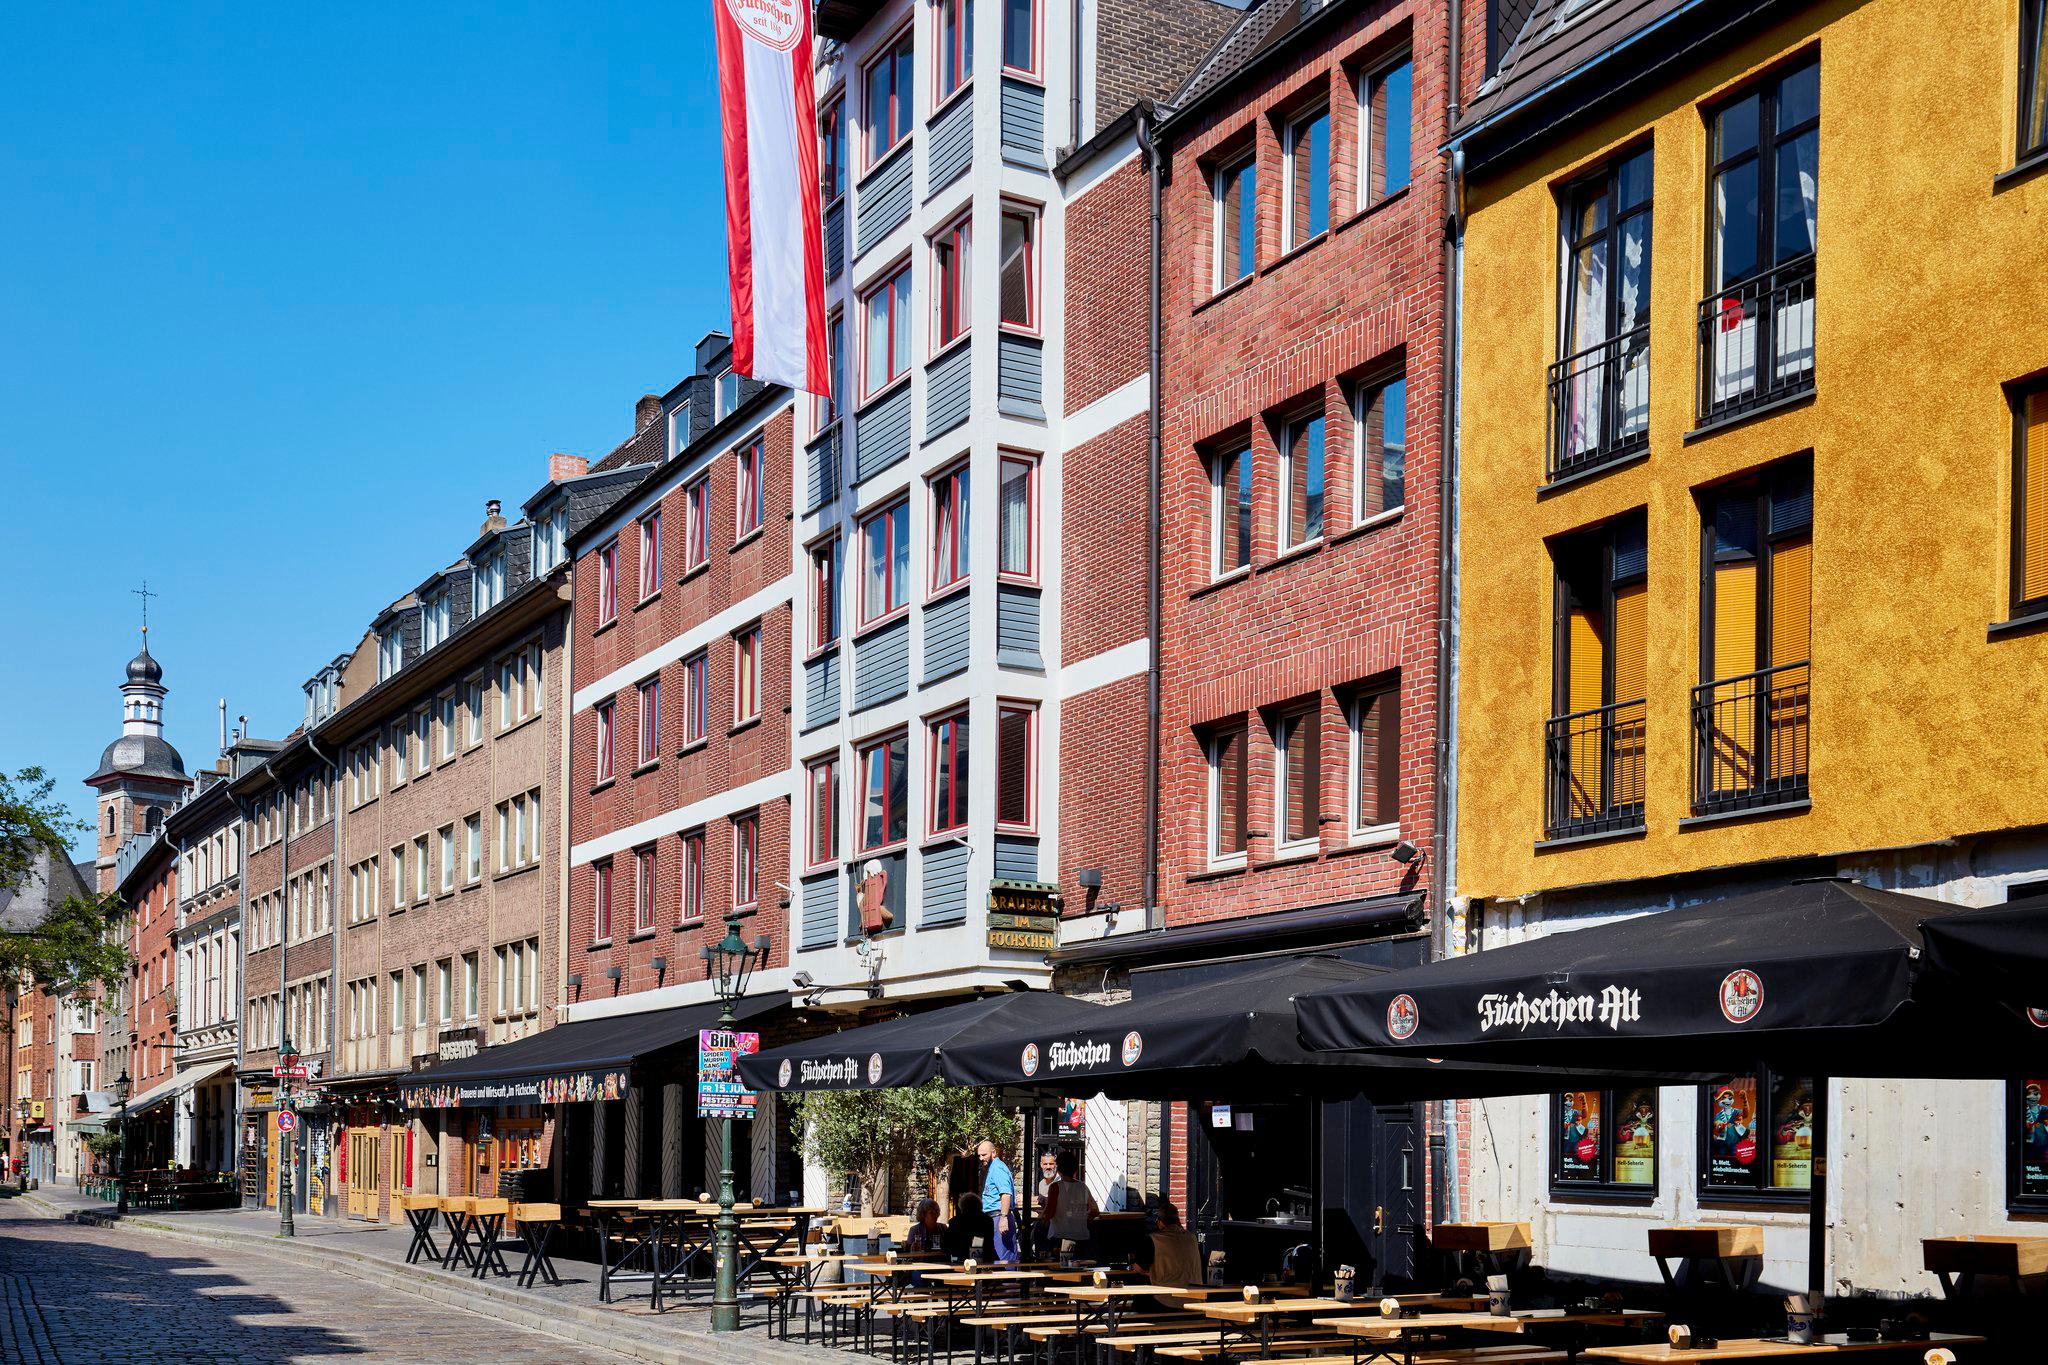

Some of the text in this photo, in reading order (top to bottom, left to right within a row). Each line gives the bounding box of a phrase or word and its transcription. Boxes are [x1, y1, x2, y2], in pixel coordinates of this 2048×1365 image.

[990, 895, 1054, 913] BRAUEREI
[1014, 915, 1030, 928] IM
[1477, 984, 1642, 1032] Füchschen Alt
[710, 1033, 737, 1048] Bilk
[1048, 1038, 1111, 1071] Füchschen
[800, 1056, 859, 1085] Füchschen Alt
[460, 1087, 478, 1099] Brauerei
[701, 1096, 738, 1104] FESTZELT
